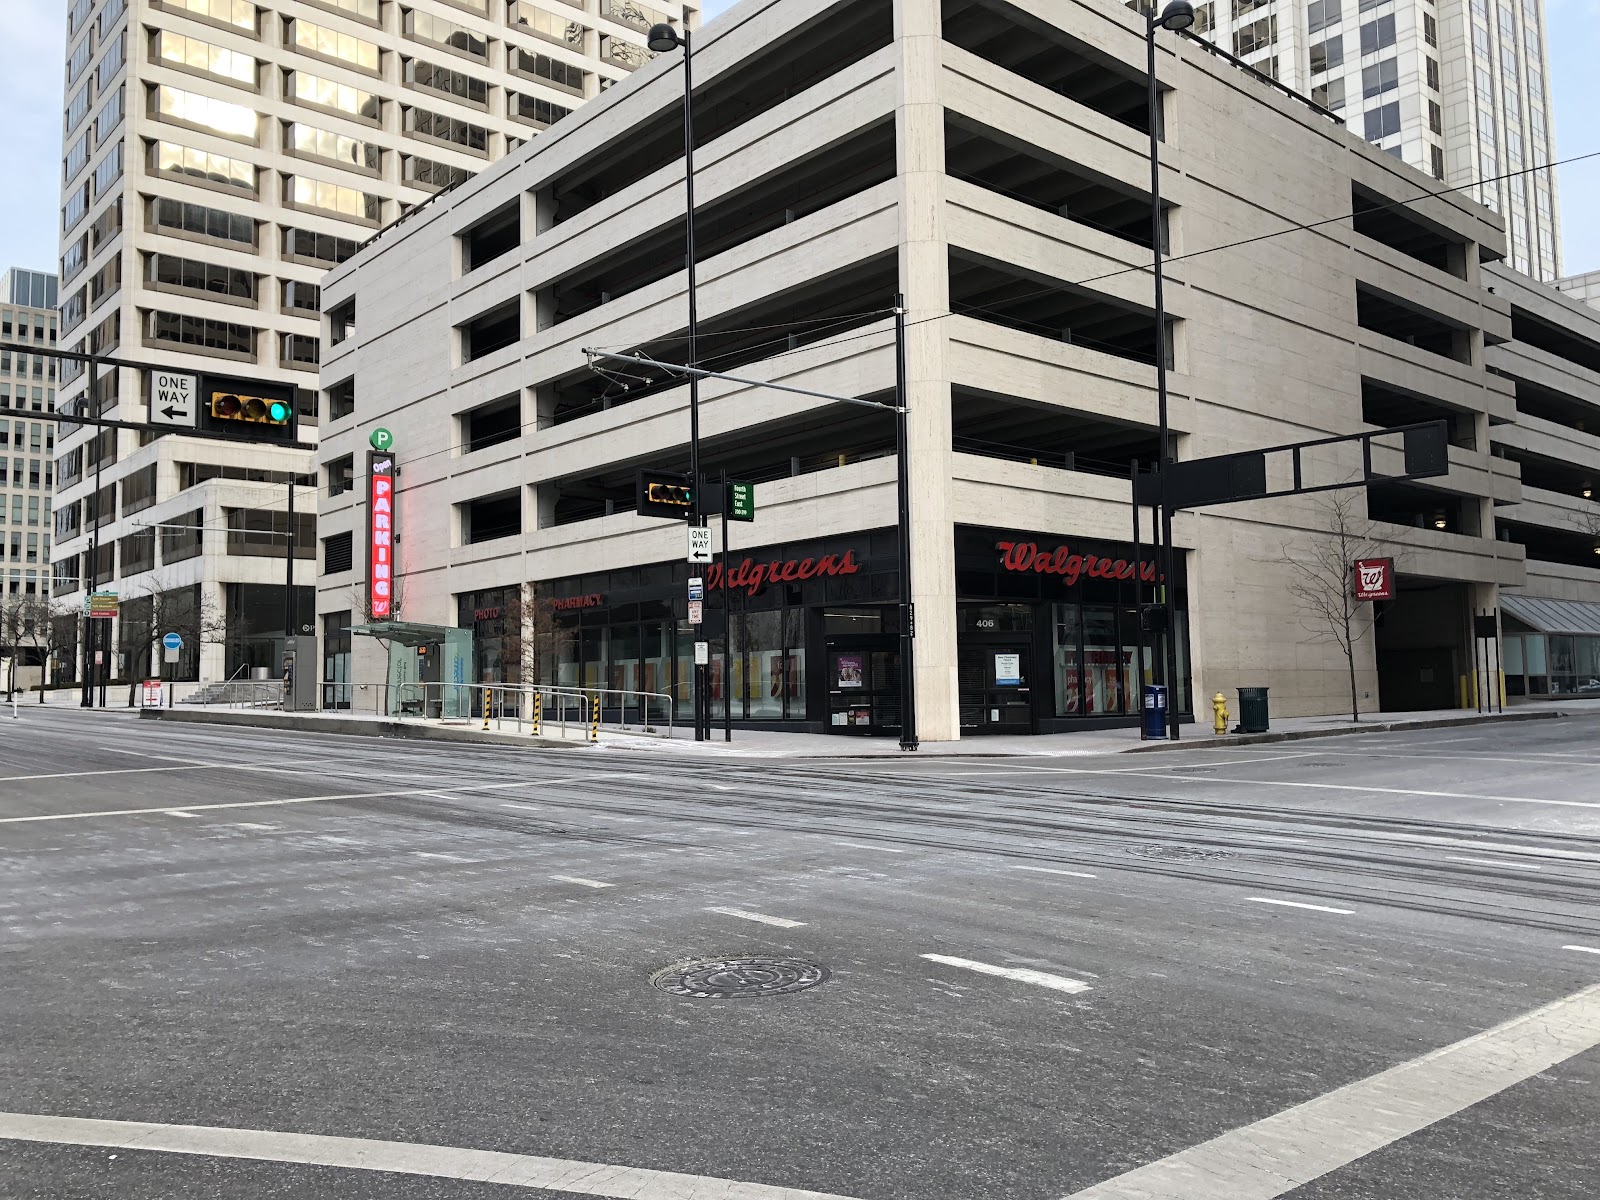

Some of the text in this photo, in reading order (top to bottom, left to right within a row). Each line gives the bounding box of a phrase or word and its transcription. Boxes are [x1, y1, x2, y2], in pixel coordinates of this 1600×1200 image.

[159, 376, 188, 390] ONE
[158, 390, 189, 404] WAY
[378, 431, 388, 445] P
[373, 459, 392, 473] Open
[734, 492, 746, 500] Street
[374, 480, 391, 596] PARKING
[692, 530, 708, 539] ONE
[692, 540, 709, 549] WAY
[552, 593, 602, 610] PHARMACY
[474, 607, 500, 620] PHOTO
[976, 619, 994, 627] 406
[1067, 674, 1093, 685] phacy
